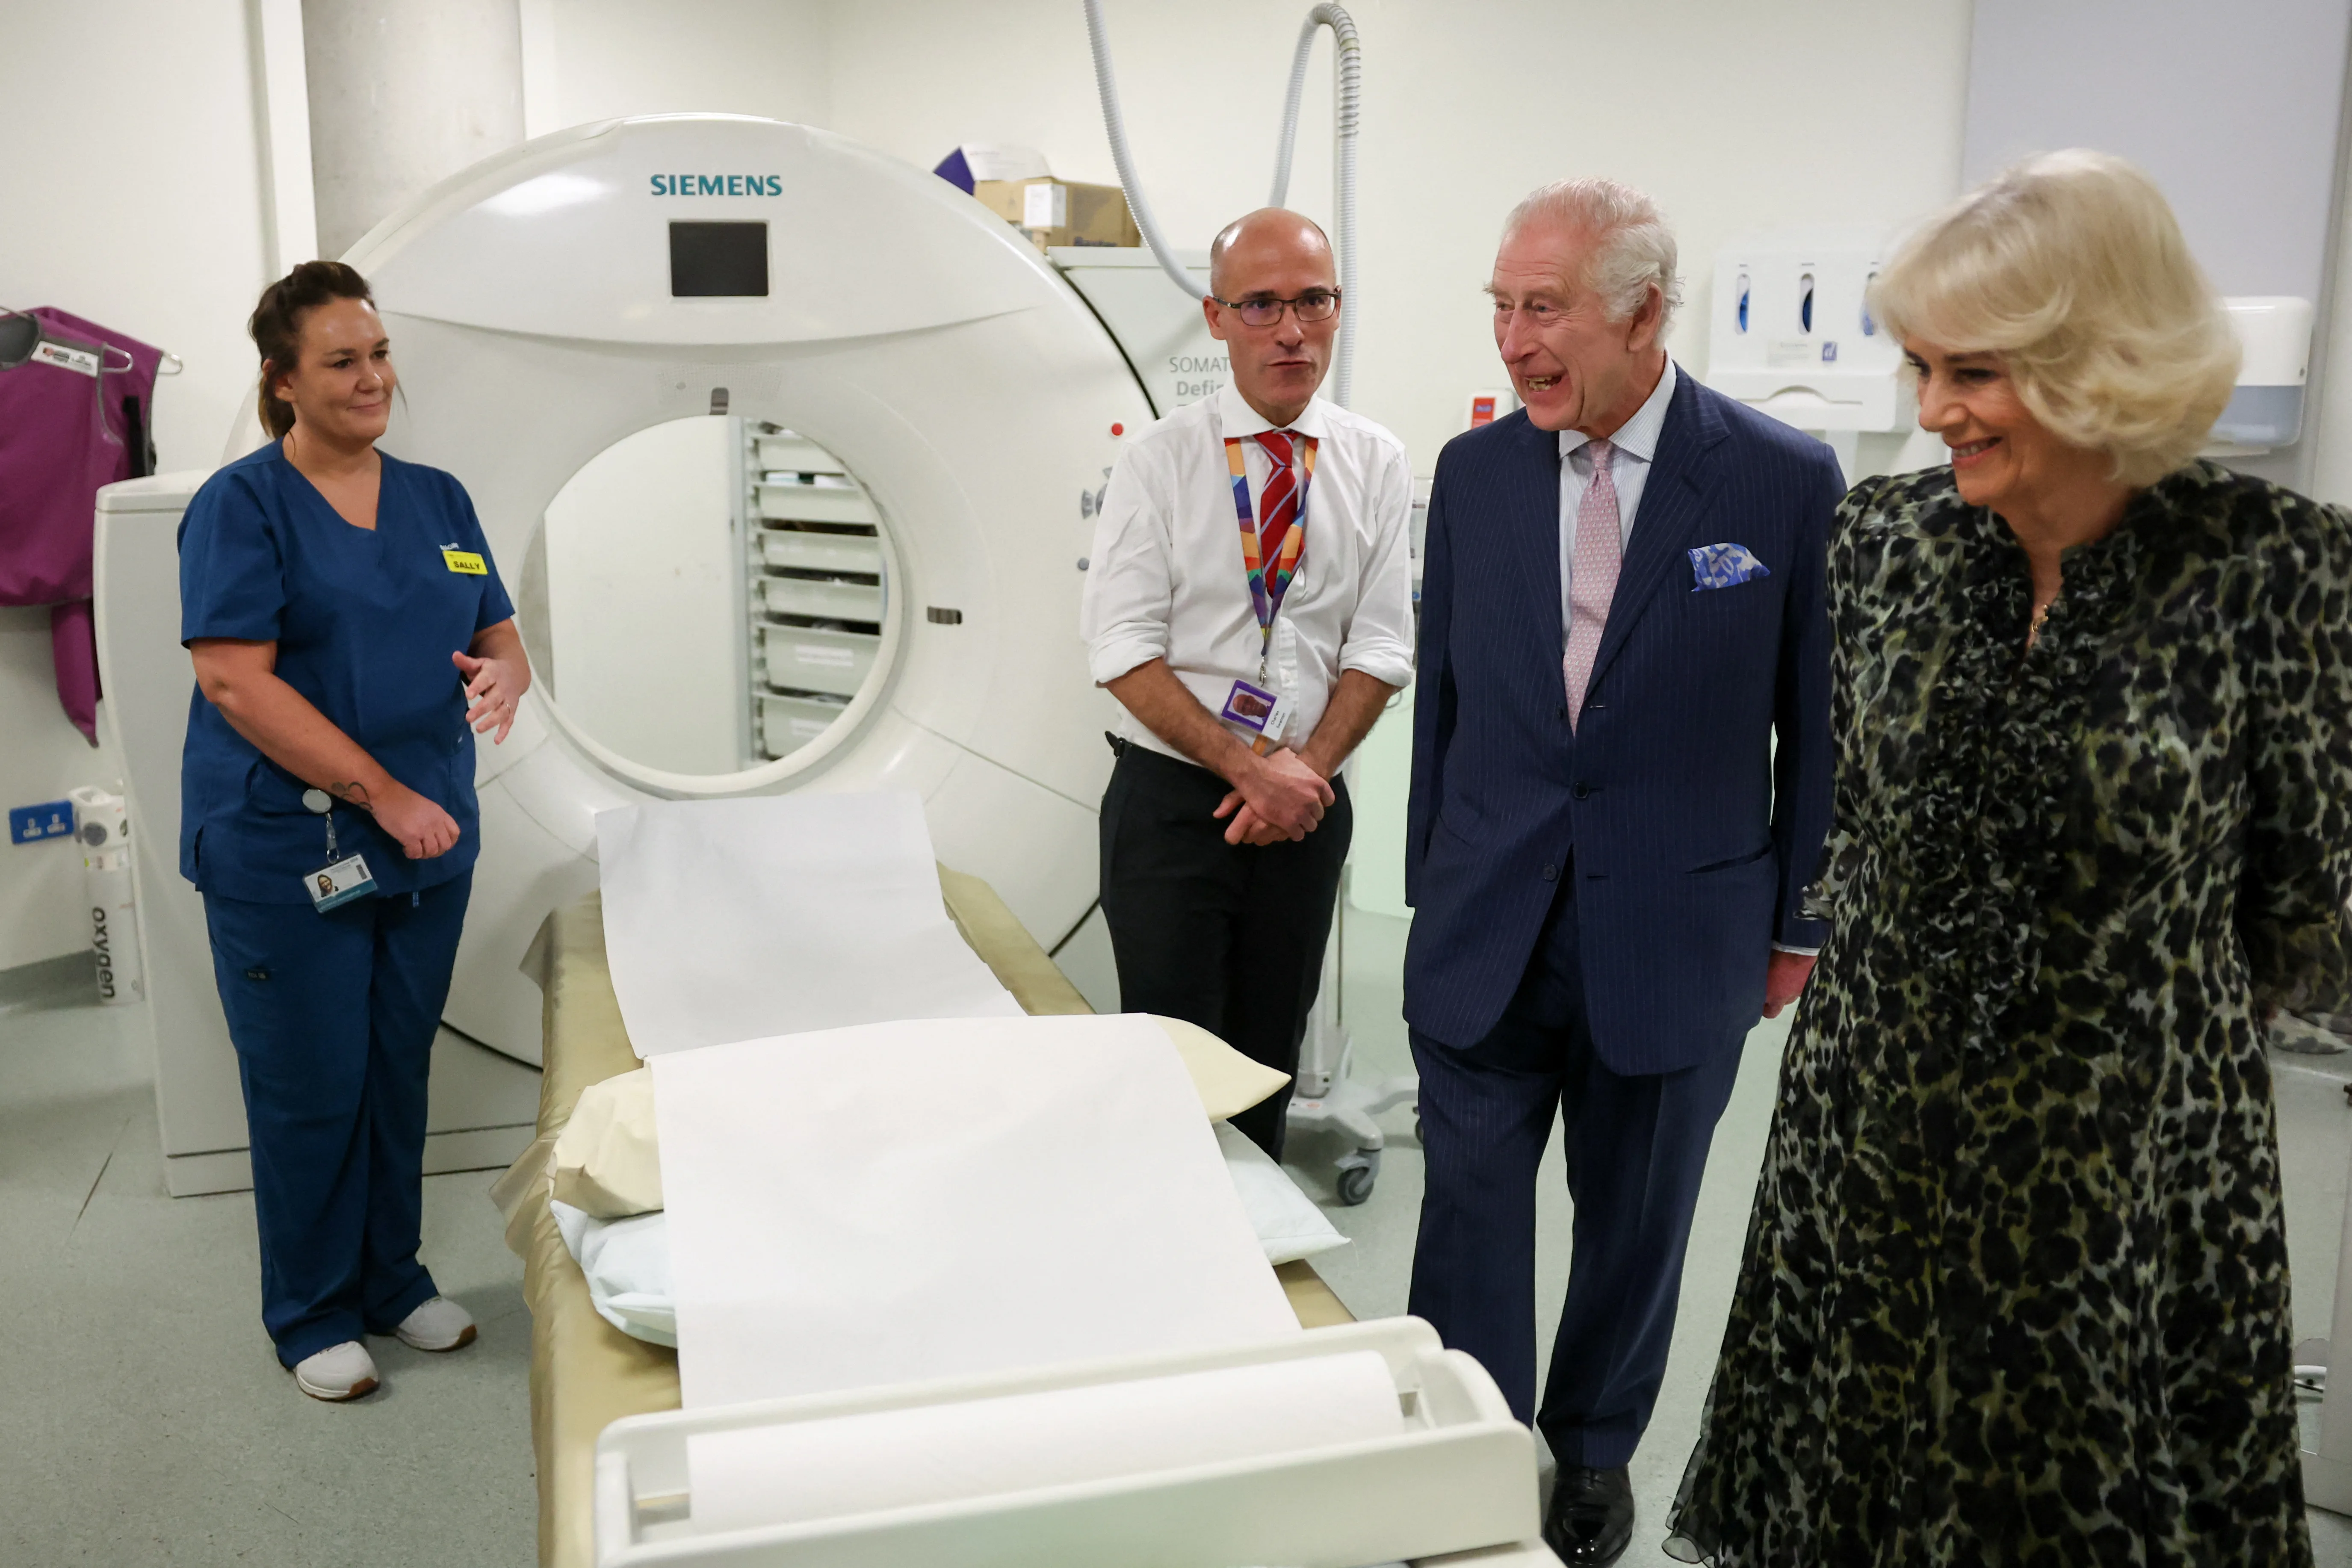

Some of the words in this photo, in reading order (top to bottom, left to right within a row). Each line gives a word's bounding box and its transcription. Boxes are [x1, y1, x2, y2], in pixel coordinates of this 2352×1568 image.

[650, 174, 782, 196] SIEMENS
[453, 561, 479, 570] SALLY
[92, 906, 115, 998] oxygen
